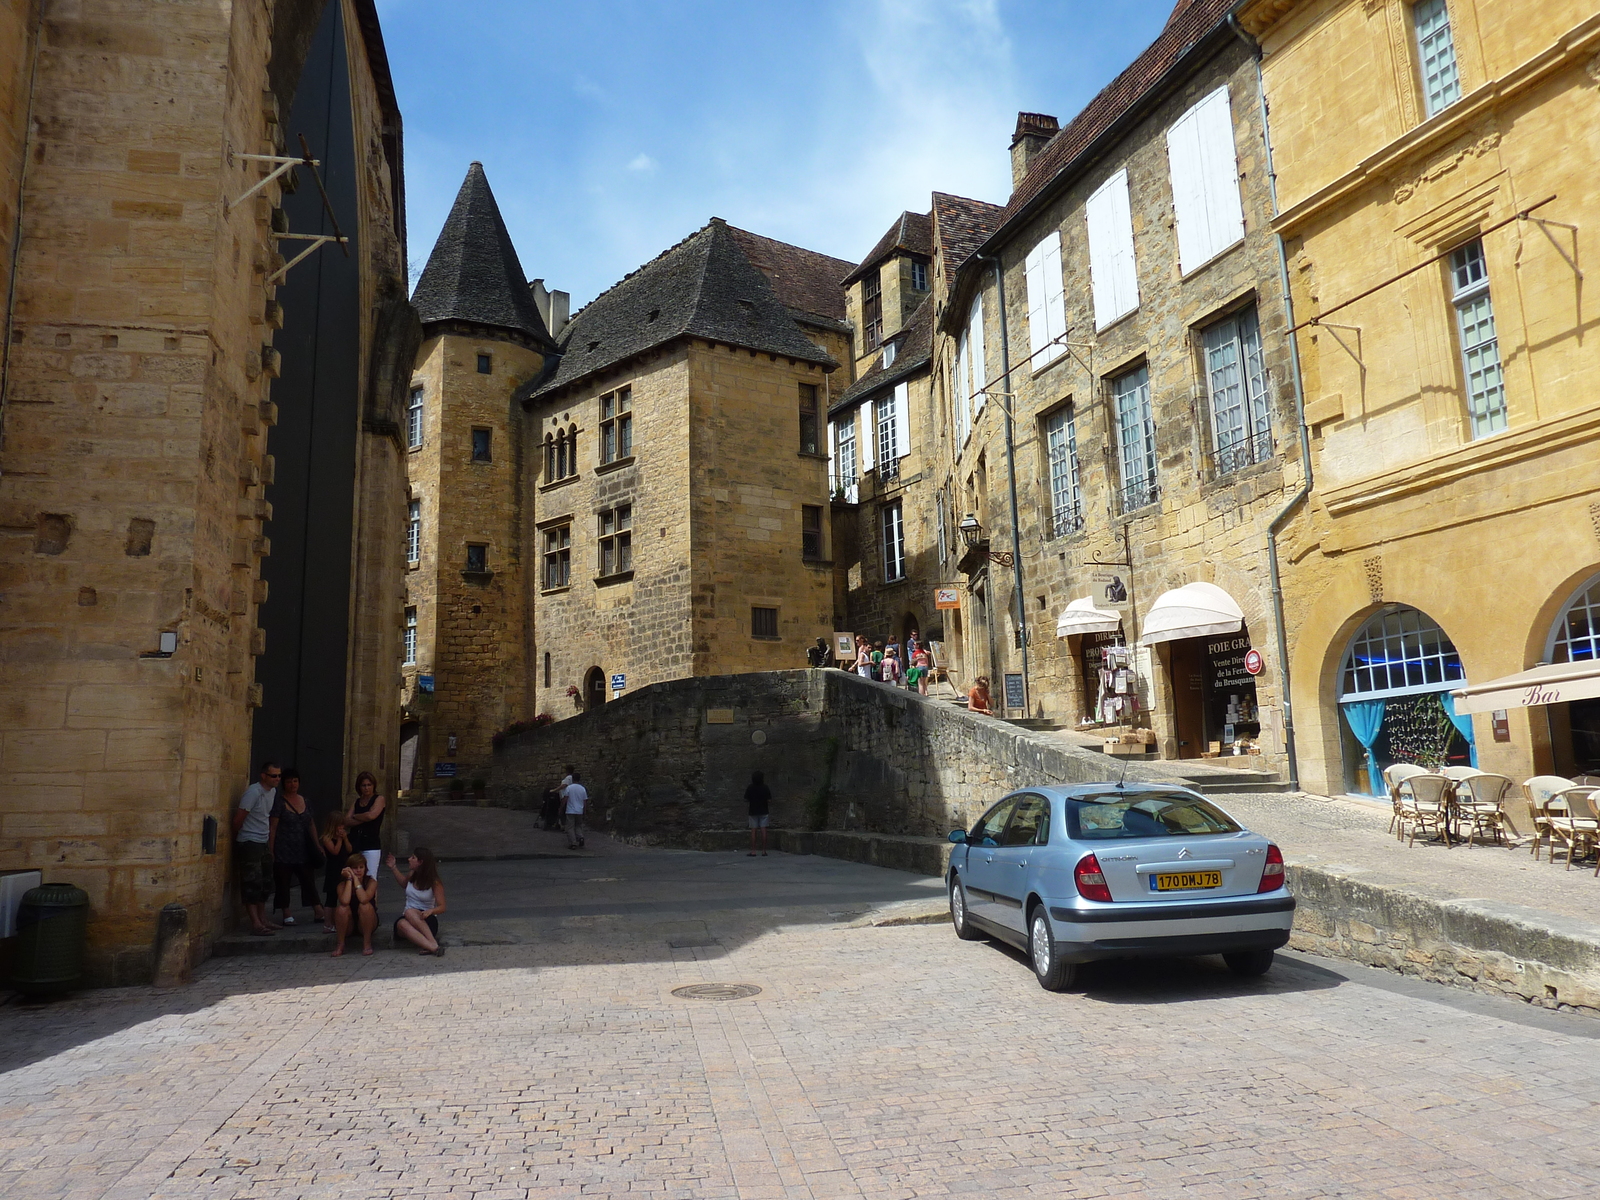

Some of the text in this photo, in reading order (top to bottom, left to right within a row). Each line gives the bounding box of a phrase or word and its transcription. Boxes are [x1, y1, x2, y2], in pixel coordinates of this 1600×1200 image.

[1207, 637, 1252, 655] FOIE GRA
[1213, 656, 1245, 668] Vente Dire
[1217, 667, 1248, 678] de la Ferm
[1214, 679, 1223, 688] du
[1522, 684, 1561, 706] Bar
[1159, 873, 1219, 888] 170 DMJ 78
